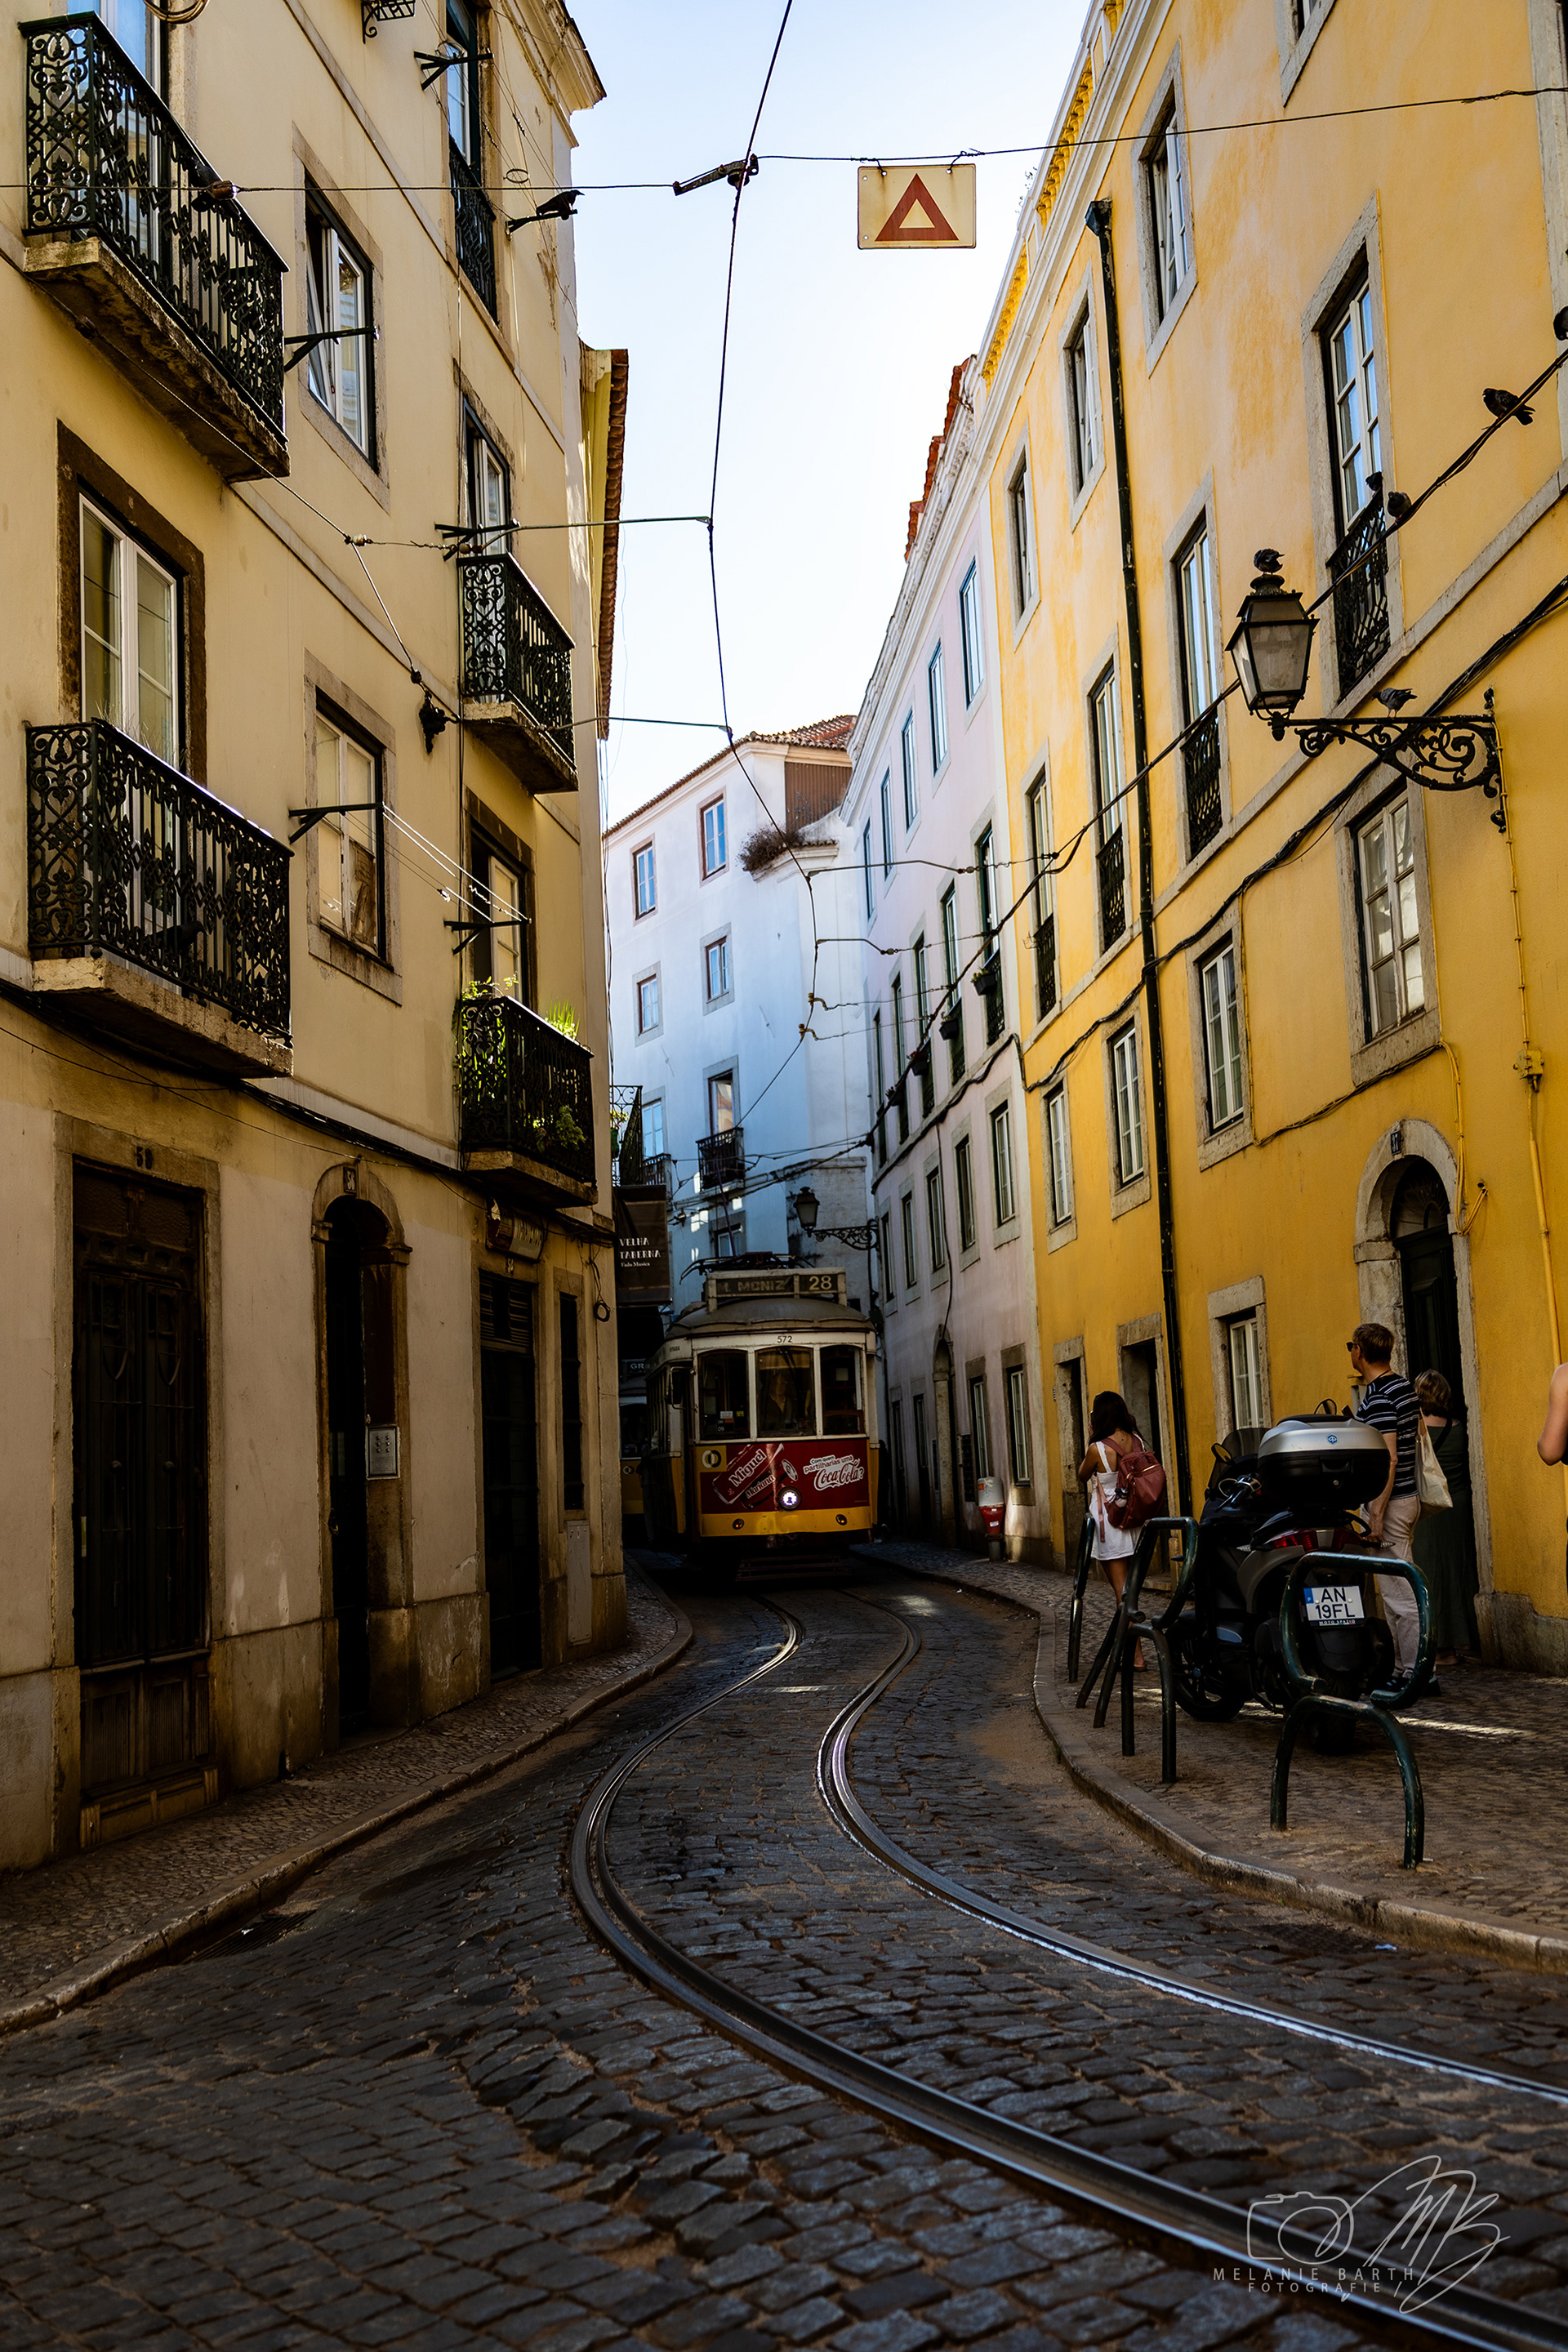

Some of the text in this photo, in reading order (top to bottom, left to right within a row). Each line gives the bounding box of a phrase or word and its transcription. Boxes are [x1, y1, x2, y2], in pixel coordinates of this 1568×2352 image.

[619, 1237, 649, 1246] VELHA
[620, 1250, 661, 1259] TABERNA
[737, 1280, 786, 1291] MONIZ
[808, 1275, 833, 1291] 28
[777, 1335, 793, 1343] 572
[728, 1449, 767, 1487] Miguel
[804, 1459, 841, 1474] partilharias
[745, 1475, 776, 1499] Mariana
[1321, 1588, 1346, 1602] AN
[1316, 1604, 1356, 1619] 19FL
